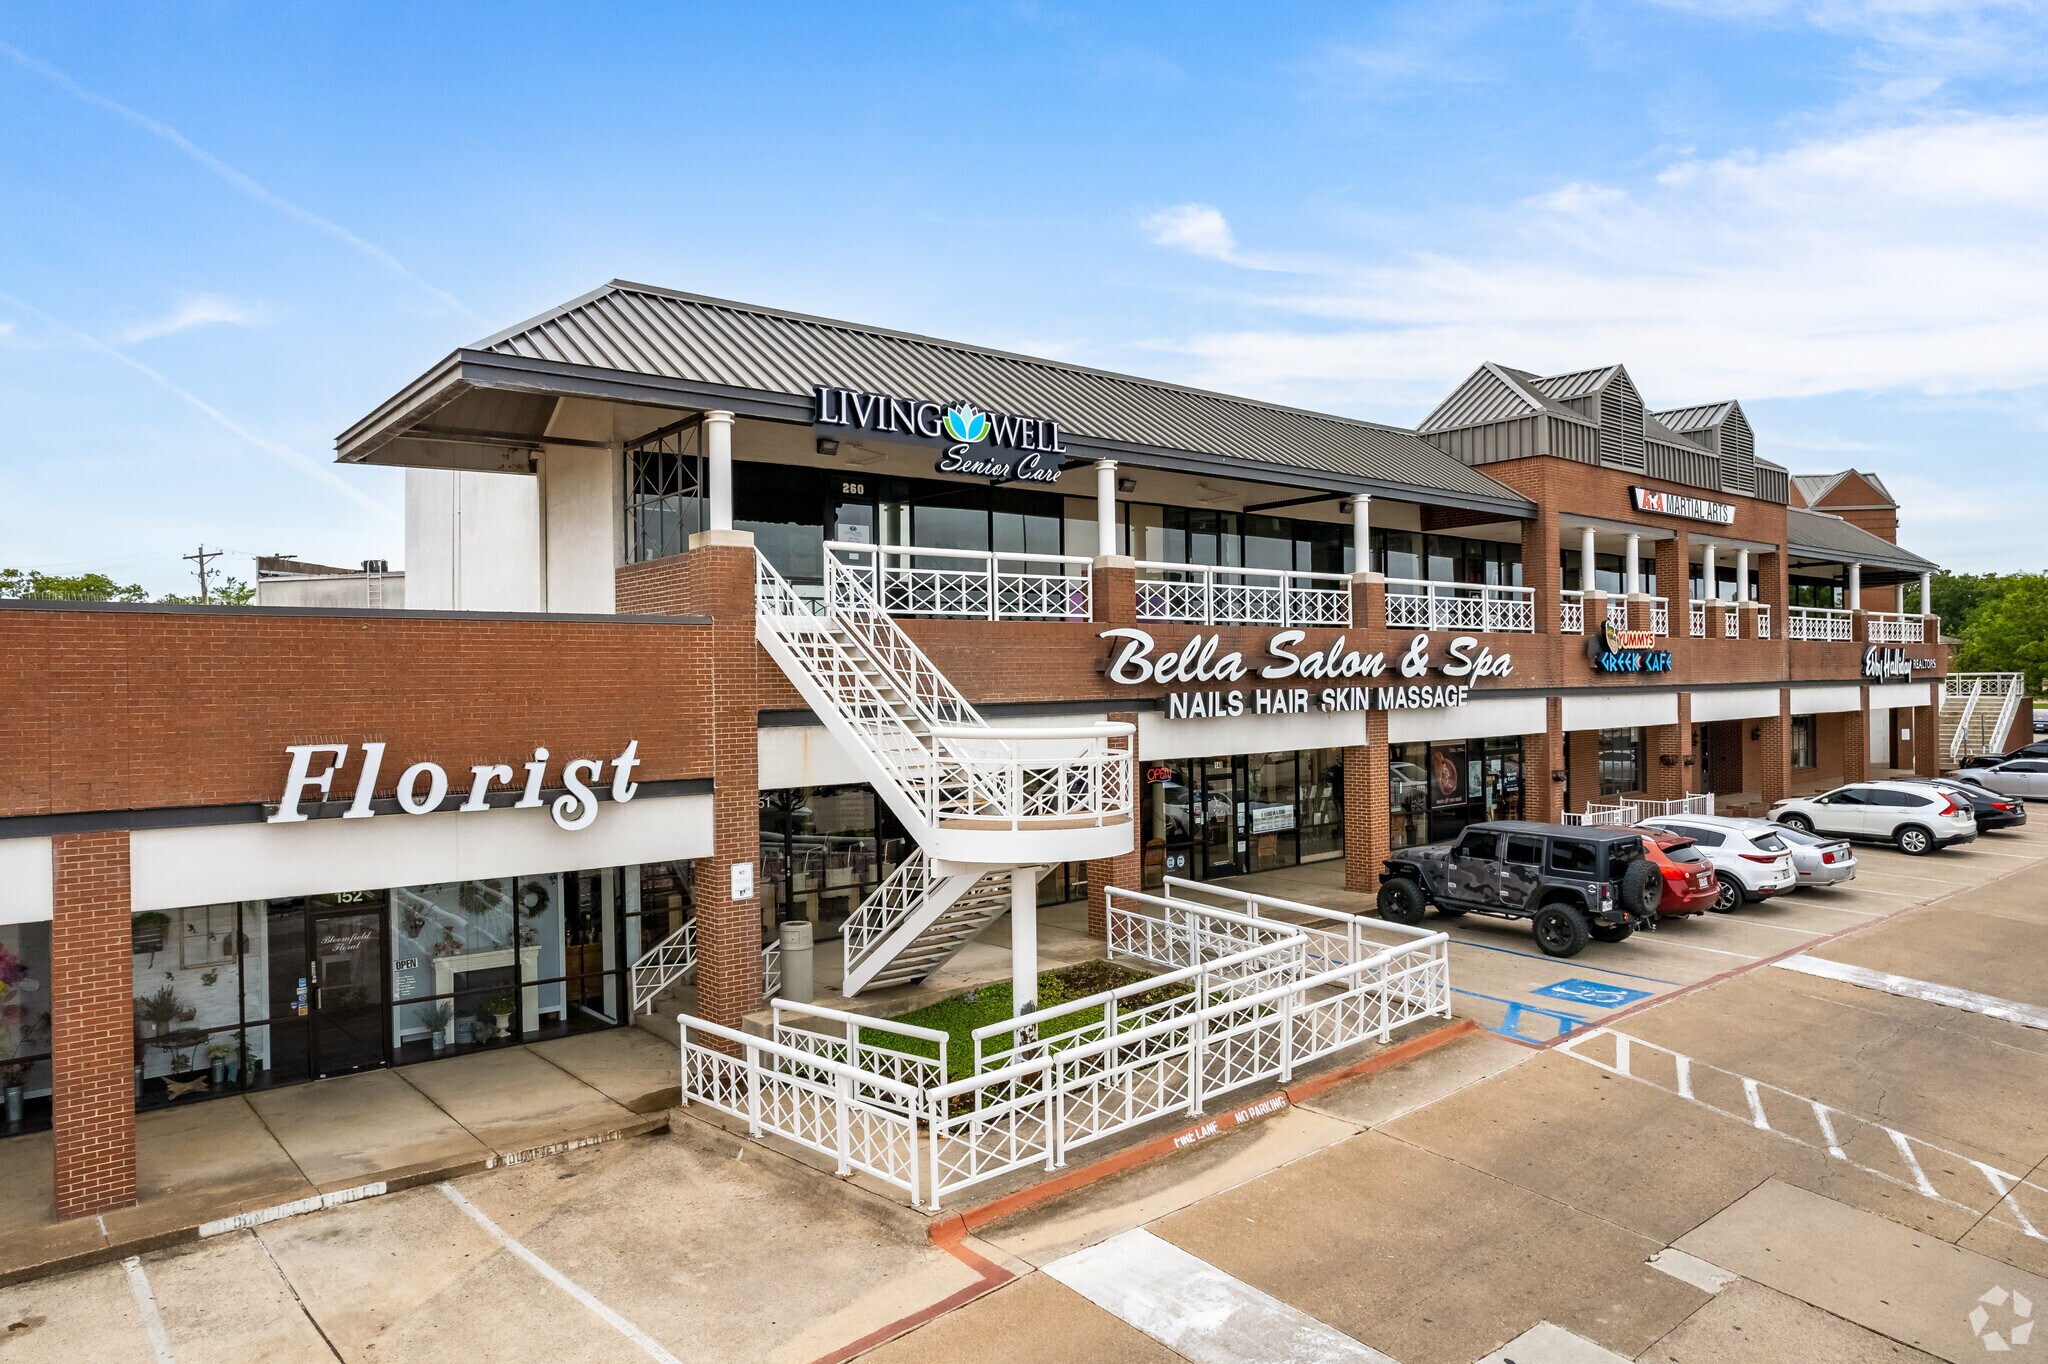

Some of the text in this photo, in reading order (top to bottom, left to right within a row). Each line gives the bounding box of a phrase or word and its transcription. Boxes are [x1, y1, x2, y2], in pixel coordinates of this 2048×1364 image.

[819, 387, 1067, 453] LIVING WELL
[940, 443, 1063, 483] Senior Care
[842, 482, 864, 495] 260
[1666, 494, 1705, 518] MARTIAL
[1707, 502, 1728, 522] ARTS
[1617, 631, 1655, 648] YUMMYS
[1099, 628, 1514, 688] Bella Salon & Spa
[1601, 652, 1672, 672] GREEK CAFE
[1865, 645, 1883, 684] Ebby
[1883, 647, 1912, 683] Halliday
[1170, 685, 1469, 720] NAILS HAIR SKIN MASSAGE
[266, 739, 641, 831] Florist
[1147, 768, 1172, 782] OPEN
[335, 891, 363, 904] 152
[320, 930, 372, 944] Bloomfield
[331, 940, 362, 952] Floral
[395, 958, 417, 971] OPEN
[1234, 1110, 1249, 1124] NO
[1249, 1096, 1286, 1118] PARKING
